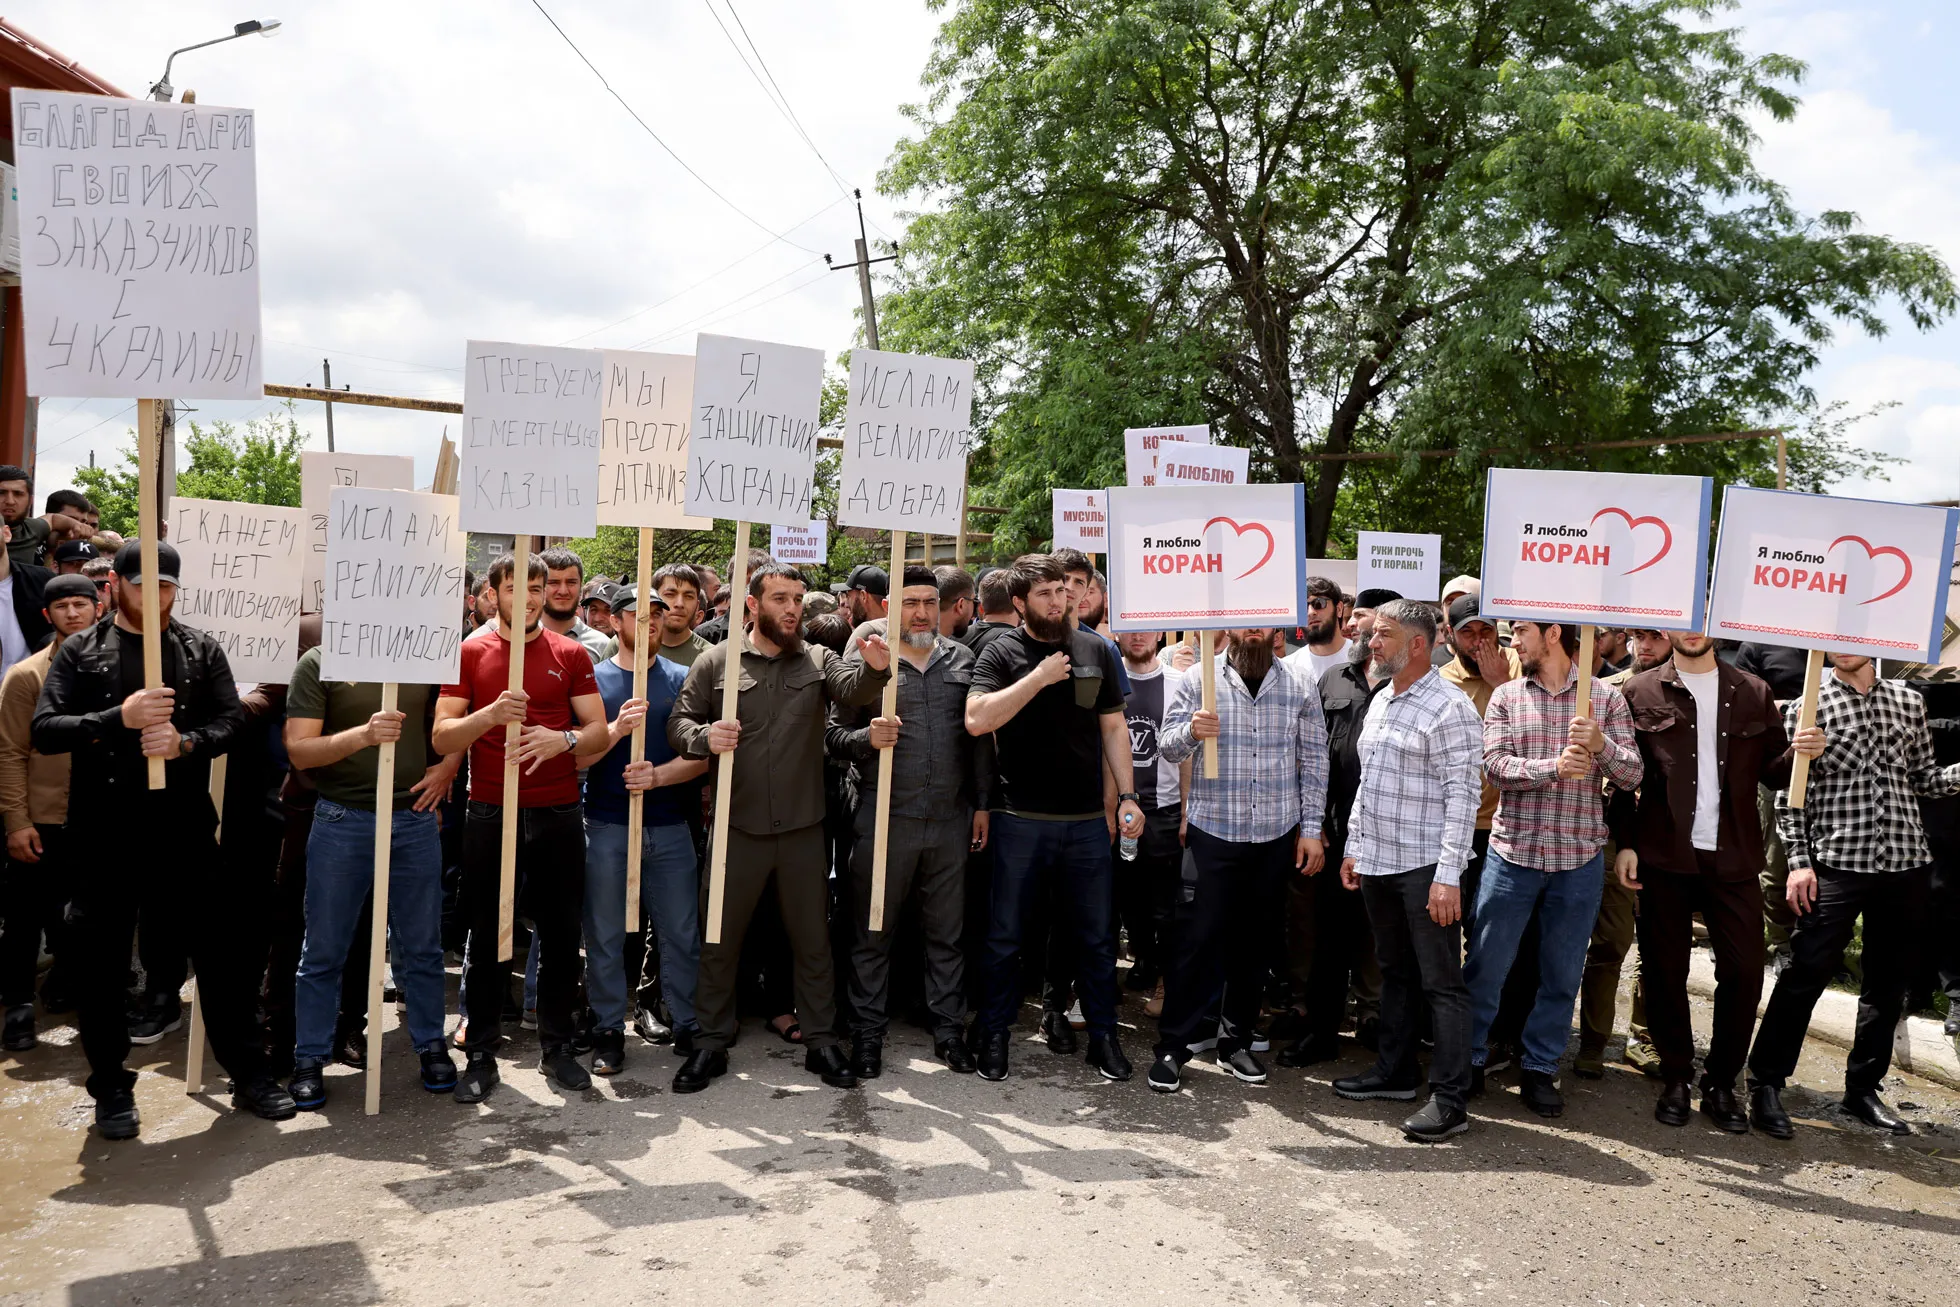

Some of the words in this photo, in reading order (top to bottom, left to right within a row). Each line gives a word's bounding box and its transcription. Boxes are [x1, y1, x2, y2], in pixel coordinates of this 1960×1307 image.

[19, 102, 252, 151] БЛАГОДАРИ
[53, 163, 218, 209] СВОИХ
[37, 216, 255, 275] ЗАКАЗЧИКОВ
[113, 279, 136, 319] С
[46, 316, 255, 387] УКРАИНЫ
[476, 356, 601, 399] ТРЕБУЕМ
[608, 363, 666, 409] МЫ
[738, 353, 760, 403] Я
[860, 362, 960, 412] ИСЛАМ
[470, 417, 598, 448] СМЕРТНУЮ
[699, 405, 817, 462] ЗАЩИТНИК
[858, 422, 969, 462] РЕЛИГИЯ
[474, 466, 580, 510] КАЗНЬ
[695, 456, 810, 514] КОРАНА
[1165, 463, 1175, 478] Я
[1177, 464, 1235, 485] ЛЮБЛЮ
[848, 478, 962, 521] ДОБРА!
[1063, 510, 1106, 523] МУСУЛЬ
[176, 509, 297, 556] СКАЖЕМ
[341, 500, 450, 553] ИСЛАМ
[777, 536, 806, 546] ПРОЧЬ
[807, 537, 819, 547] ОТ
[1079, 526, 1104, 538] НИН!
[1143, 537, 1152, 549] Я
[1156, 536, 1202, 549] люблю
[1523, 523, 1534, 535] Я
[1538, 524, 1589, 538] люблю
[211, 553, 272, 579] НЕТ
[777, 548, 817, 559] ИСЛАМА!
[1143, 553, 1223, 575] КОРАН
[1371, 545, 1393, 556] РУКИ
[1395, 546, 1424, 558] ПРОЧЬ
[1371, 558, 1382, 569] ОТ
[1521, 541, 1611, 567] КОРАН
[1757, 546, 1768, 559] Я
[1772, 550, 1825, 565] люблю
[335, 558, 464, 601] РЕЛИГИЯ
[1753, 564, 1848, 595] КОРАН
[325, 620, 461, 668] ТЕРПИМОСТИ
